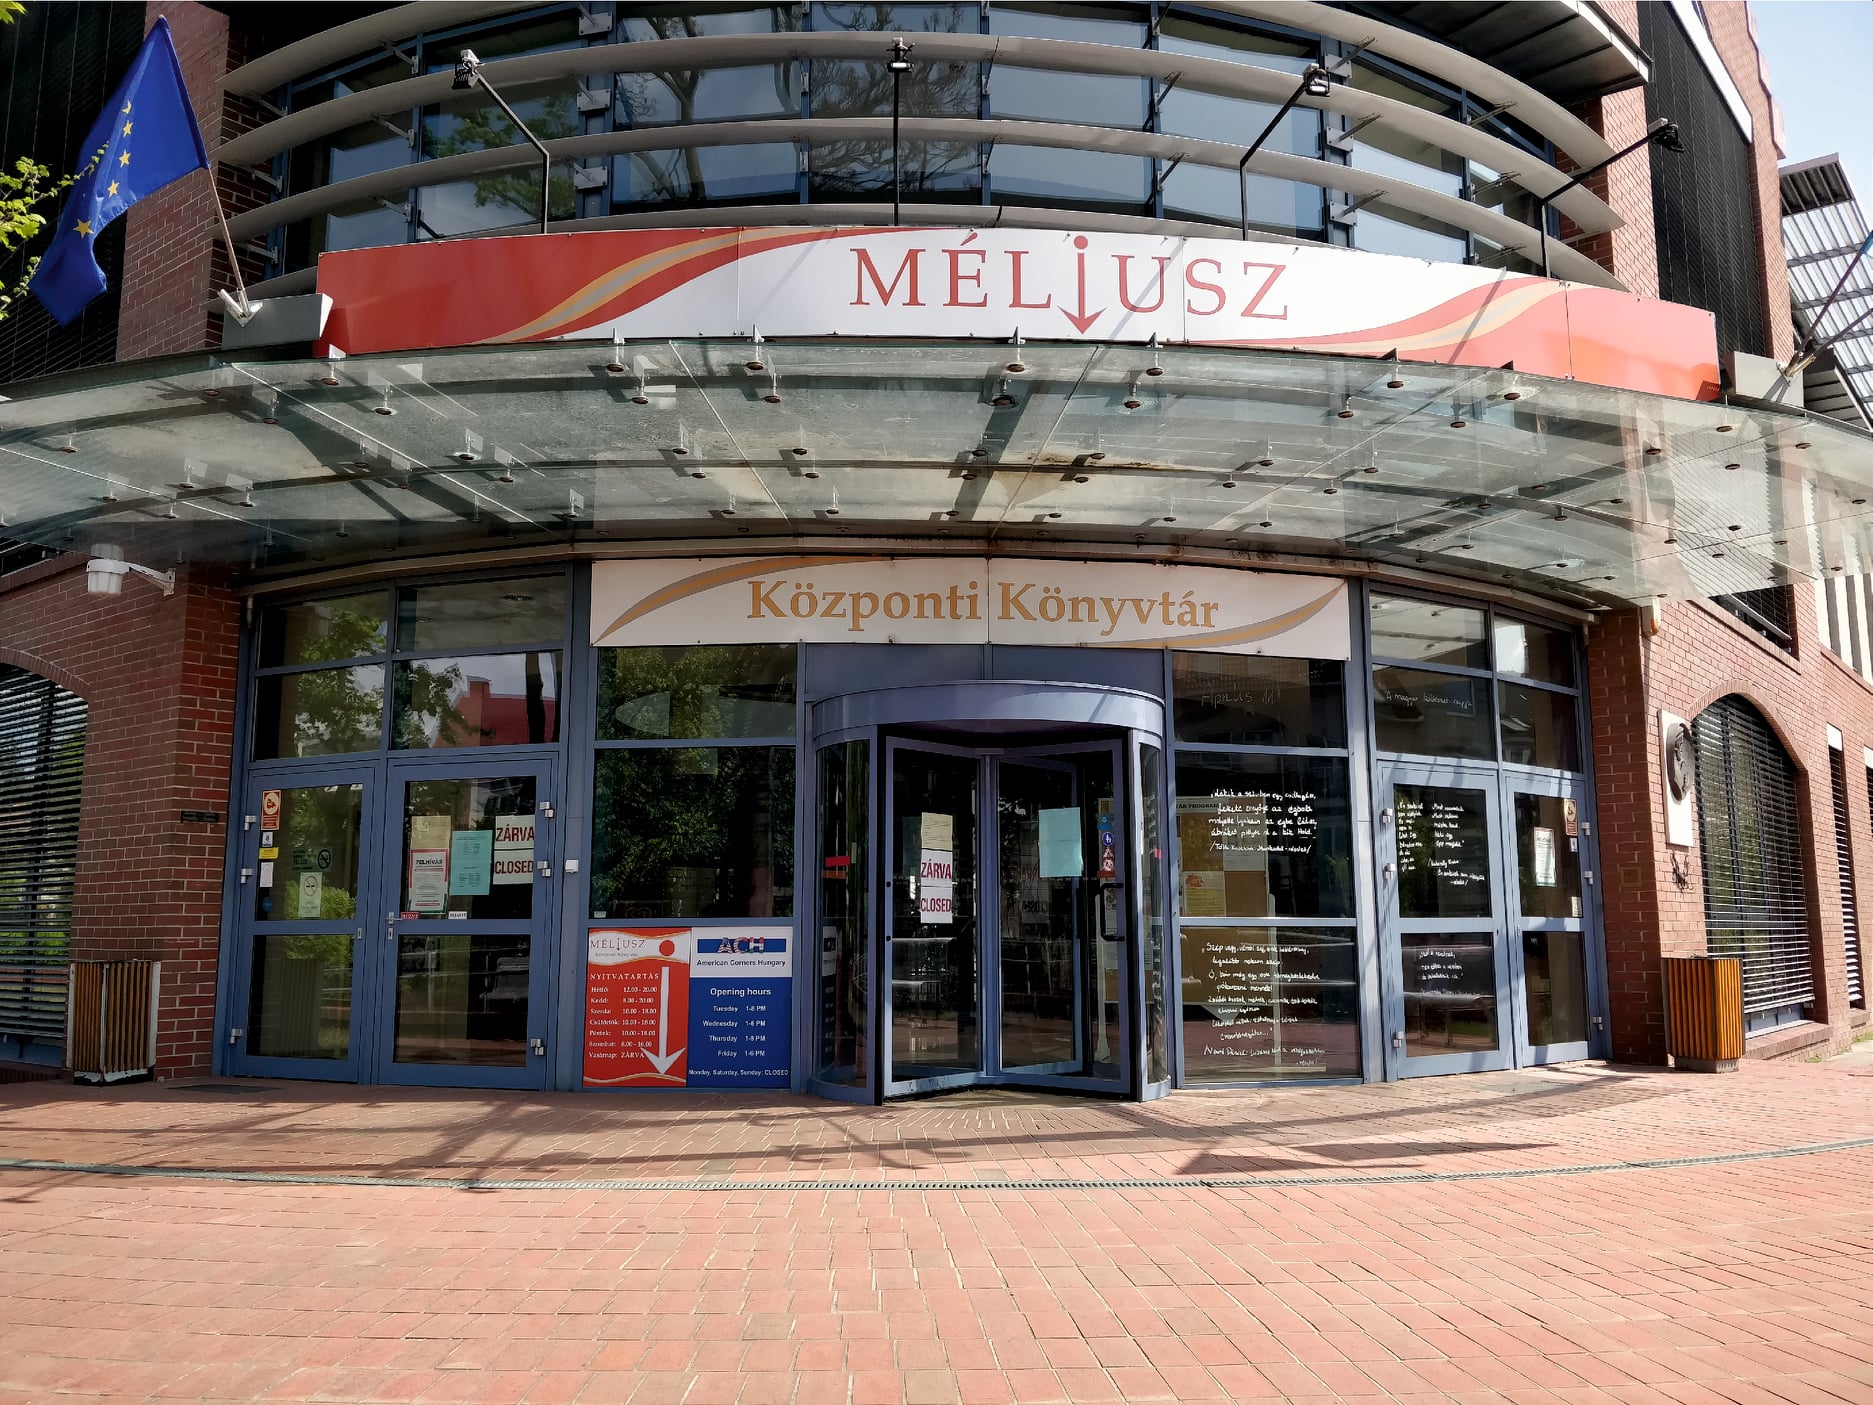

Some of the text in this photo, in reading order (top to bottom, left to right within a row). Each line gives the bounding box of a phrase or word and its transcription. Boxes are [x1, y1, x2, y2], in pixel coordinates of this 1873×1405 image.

[747, 579, 1219, 636] Központi Könyvtár
[496, 823, 535, 842] ZÁRVA
[494, 860, 534, 875] CLOSED
[921, 858, 951, 879] ZÁRVA
[920, 897, 951, 913] CLOSED
[716, 936, 765, 955] ACH
[696, 959, 786, 968] American Corners Hungary
[590, 972, 660, 981] NYITVATARTÁS
[710, 988, 772, 998] Opening hours
[712, 1005, 739, 1013] Tuesday
[702, 1020, 739, 1028] Wednesday
[709, 1035, 738, 1043] Thursday
[717, 1050, 738, 1058] Friday
